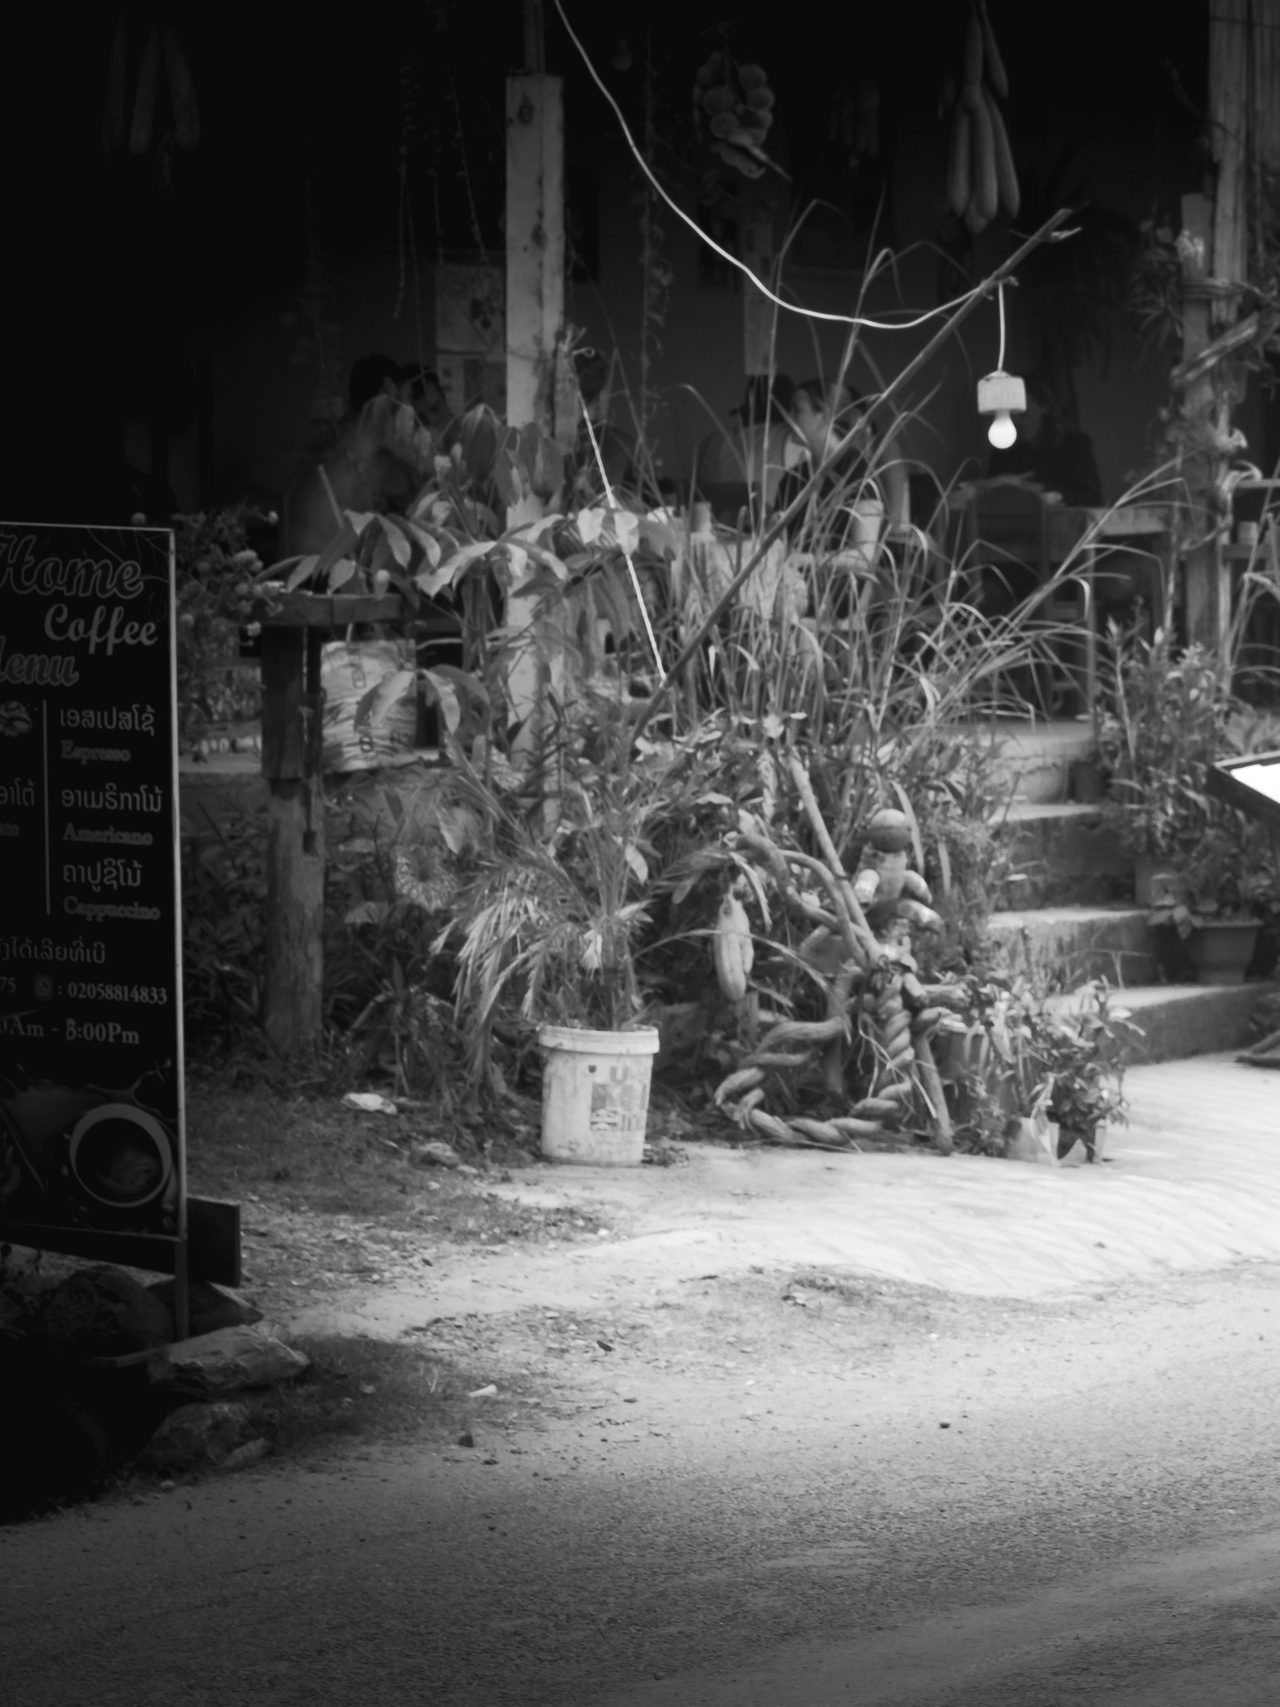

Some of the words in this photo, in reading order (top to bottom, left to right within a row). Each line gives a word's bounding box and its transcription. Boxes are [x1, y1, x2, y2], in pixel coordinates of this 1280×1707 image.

[44, 603, 158, 656] Coffee
[0, 634, 80, 687] enu
[62, 822, 154, 846] Americano
[65, 1017, 140, 1045] 8:00Pm
